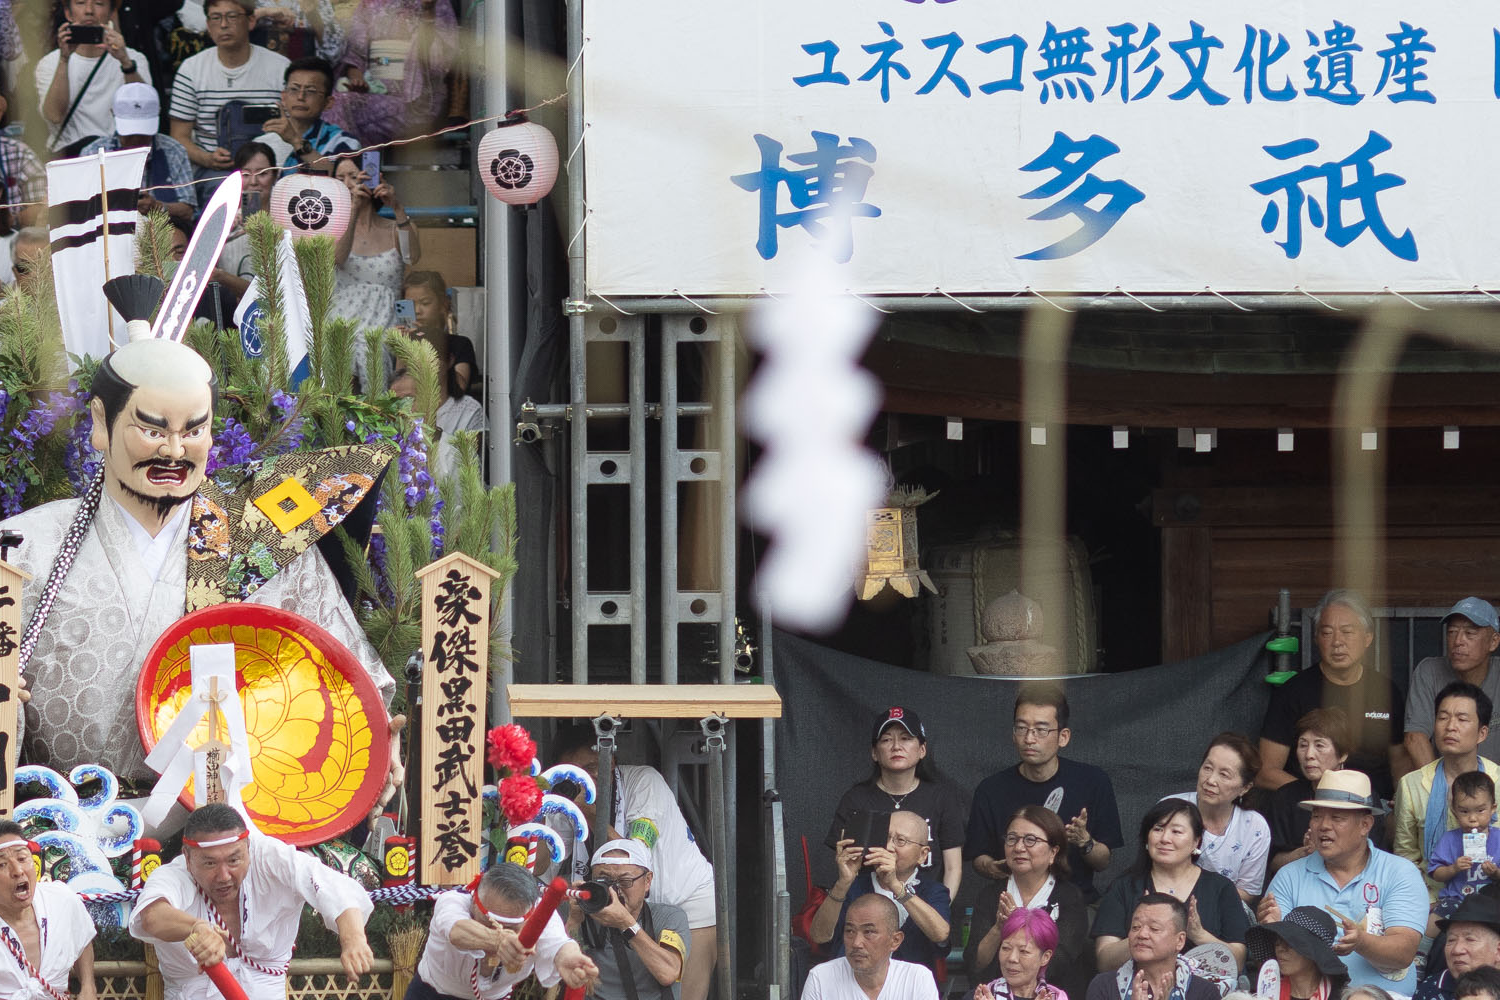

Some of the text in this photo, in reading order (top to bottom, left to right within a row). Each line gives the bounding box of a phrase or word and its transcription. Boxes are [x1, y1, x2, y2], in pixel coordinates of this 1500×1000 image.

[792, 20, 1437, 105] ユネスコ無形文化遺産
[889, 706, 904, 720] B
